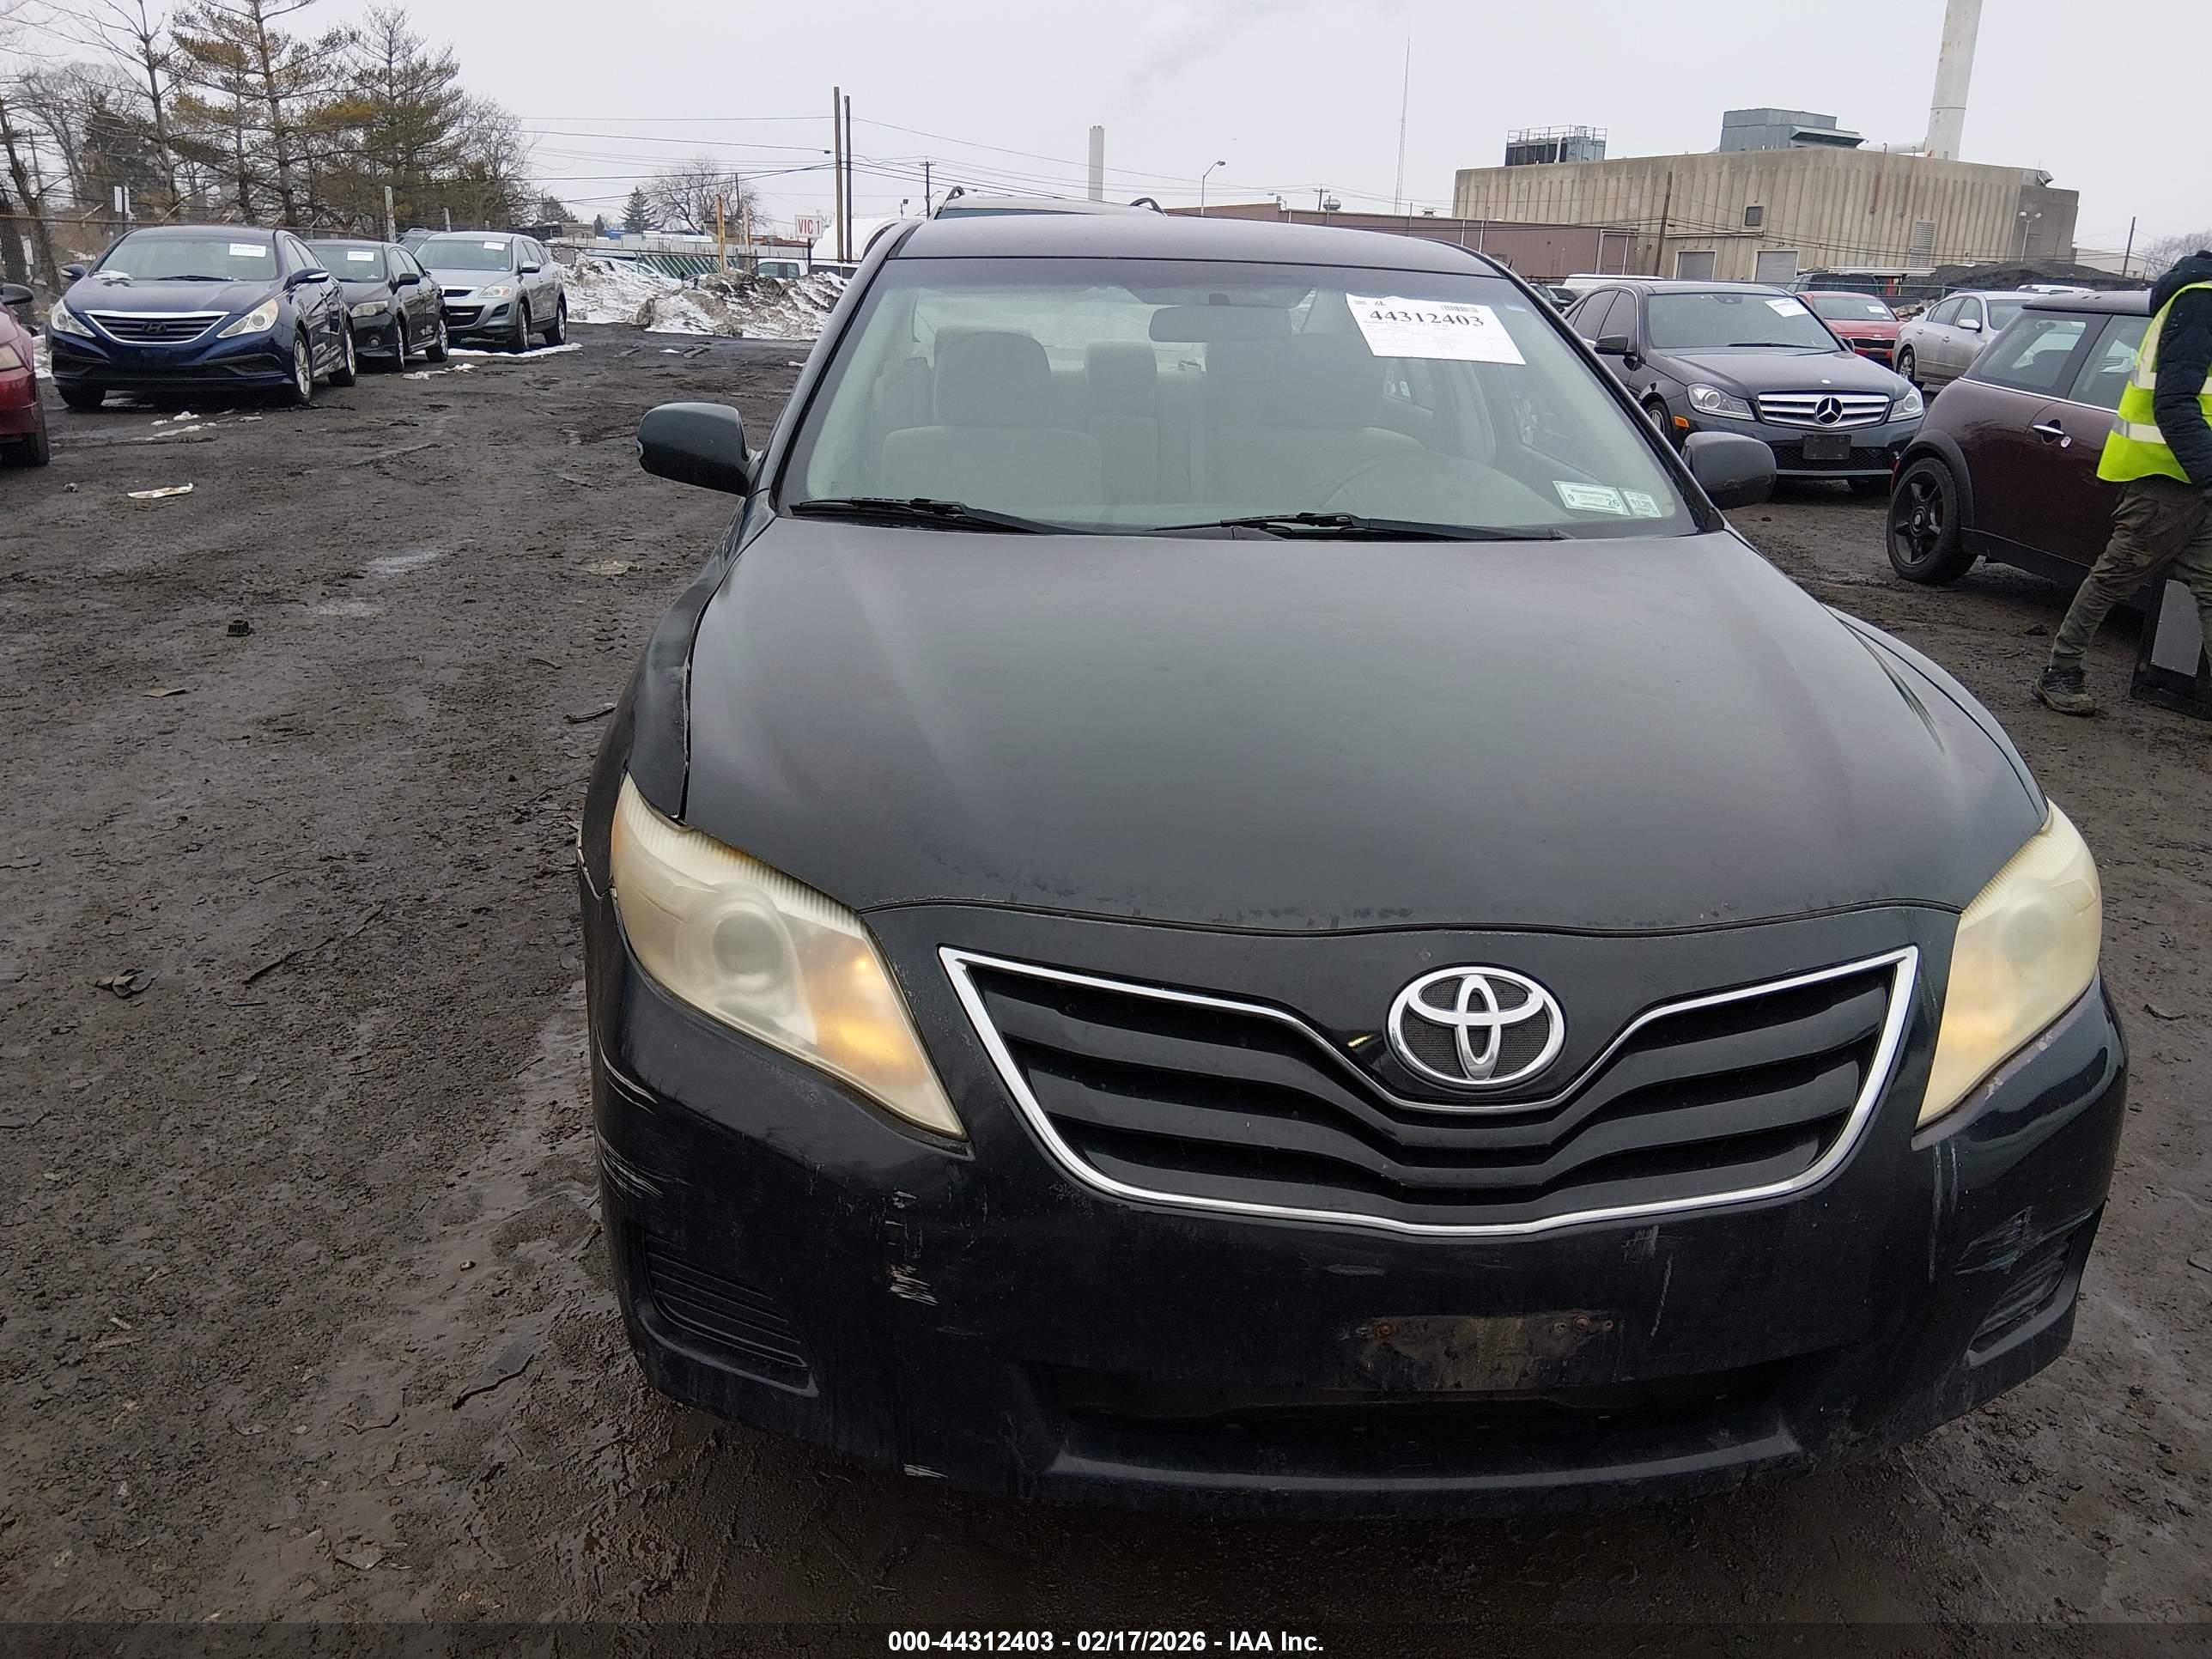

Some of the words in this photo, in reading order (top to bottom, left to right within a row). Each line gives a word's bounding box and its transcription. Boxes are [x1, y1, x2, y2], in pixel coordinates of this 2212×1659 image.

[798, 219, 813, 234] VIC
[1370, 310, 1484, 326] 44312403
[1606, 498, 1620, 507] 26
